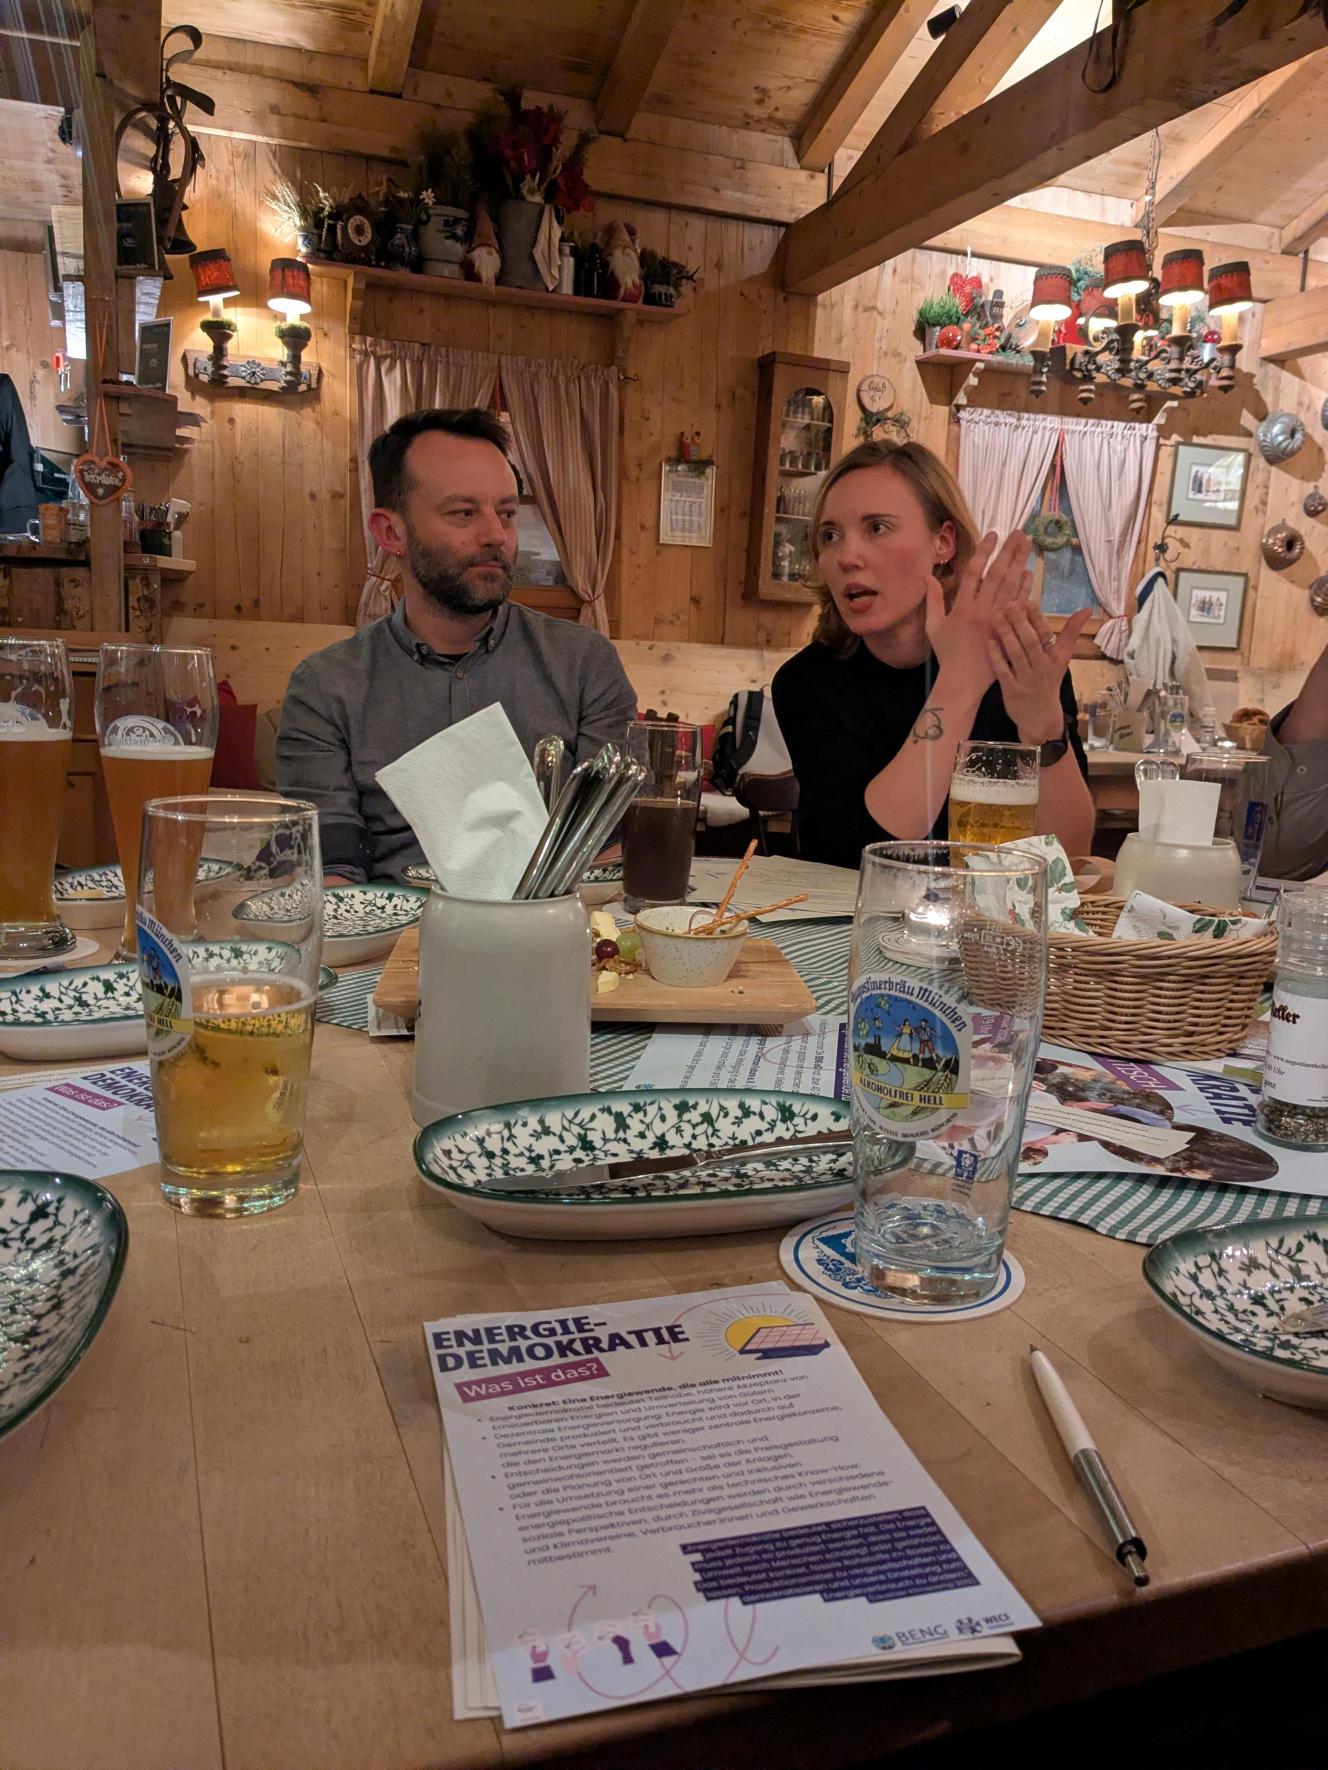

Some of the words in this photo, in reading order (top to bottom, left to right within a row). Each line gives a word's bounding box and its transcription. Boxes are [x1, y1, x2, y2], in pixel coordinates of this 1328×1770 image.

[147, 916, 182, 963] München
[157, 1017, 173, 1030] HELL
[915, 985, 967, 1032] München
[53, 1083, 77, 1097] Was
[87, 1093, 118, 1109] das?
[858, 1075, 914, 1102] ALKOHOLFREI
[918, 1094, 944, 1106] HELL
[1186, 1072, 1257, 1127] KRATIE
[432, 1315, 607, 1351] ENERGIE-
[438, 1323, 689, 1373] DEMOKRATIE
[463, 1377, 512, 1398] Was
[516, 1370, 545, 1388] ist
[550, 1362, 598, 1382] das?
[489, 1404, 591, 1422] Energiedemokratie
[596, 1396, 645, 1408] bedeutet
[696, 1385, 734, 1394] höhere
[736, 1378, 786, 1389] Akzeptanz
[507, 1400, 559, 1411] Konkret:
[698, 1378, 719, 1386] alle
[721, 1369, 783, 1383] mitnimmt!
[493, 1427, 554, 1439] Dezentrale
[664, 1406, 705, 1416] Energie
[706, 1402, 730, 1410] wird
[496, 1436, 557, 1449] Gemeinde
[559, 1427, 616, 1442] produziert
[618, 1423, 640, 1432] und
[643, 1415, 704, 1428] verbraucht
[705, 1411, 727, 1420] und
[729, 1405, 774, 1416] dadurch
[776, 1402, 793, 1410] auf
[570, 1410, 617, 1420] Energien
[619, 1405, 641, 1413] und
[643, 1396, 715, 1410] Umverteilung
[498, 1447, 549, 1458] mehrere
[551, 1442, 576, 1450] Orte
[637, 1430, 657, 1440] gibt
[661, 1424, 705, 1435] weniger
[708, 1417, 751, 1428] zentrale
[503, 1460, 599, 1478] Entscheidungen
[601, 1453, 645, 1464] werden
[647, 1438, 744, 1459] gemeinschaftlich
[746, 1434, 768, 1443] und
[548, 1445, 625, 1462] Energiemarkt
[506, 1464, 632, 1490] gemeinwohlorientiert
[635, 1457, 688, 1471] getroffen
[699, 1452, 715, 1460] sei
[733, 1447, 752, 1455] die
[753, 1435, 839, 1452] Preisgestaltung
[509, 1491, 537, 1499] oder
[562, 1480, 611, 1491] Planung
[638, 1471, 657, 1480] Ort
[659, 1467, 683, 1477] und
[684, 1463, 720, 1473] Größe
[512, 1502, 530, 1510] Für
[534, 1498, 553, 1506] die
[556, 1488, 624, 1503] Umsetzung
[627, 1483, 656, 1492] einer
[659, 1474, 719, 1489] gerechten
[721, 1468, 744, 1478] und
[746, 1461, 802, 1474] inklusiven
[514, 1502, 603, 1520] Energiewende
[604, 1493, 653, 1506] braucht
[672, 1487, 703, 1496] mehr
[706, 1483, 724, 1491] als
[725, 1473, 796, 1488] technisches
[517, 1509, 625, 1531] energiepolitische
[627, 1495, 724, 1514] Entscheidungen
[726, 1488, 770, 1499] werden
[772, 1480, 809, 1492] durch
[809, 1471, 885, 1486] verschiedene
[520, 1530, 564, 1542] soziale
[651, 1510, 688, 1522] durch
[690, 1495, 783, 1516] Zivilgesellschaft
[785, 1493, 806, 1501] wie
[523, 1544, 549, 1554] und
[755, 1507, 779, 1517] und
[781, 1494, 875, 1513] Gewerkschaften
[894, 1623, 946, 1643] BENG
